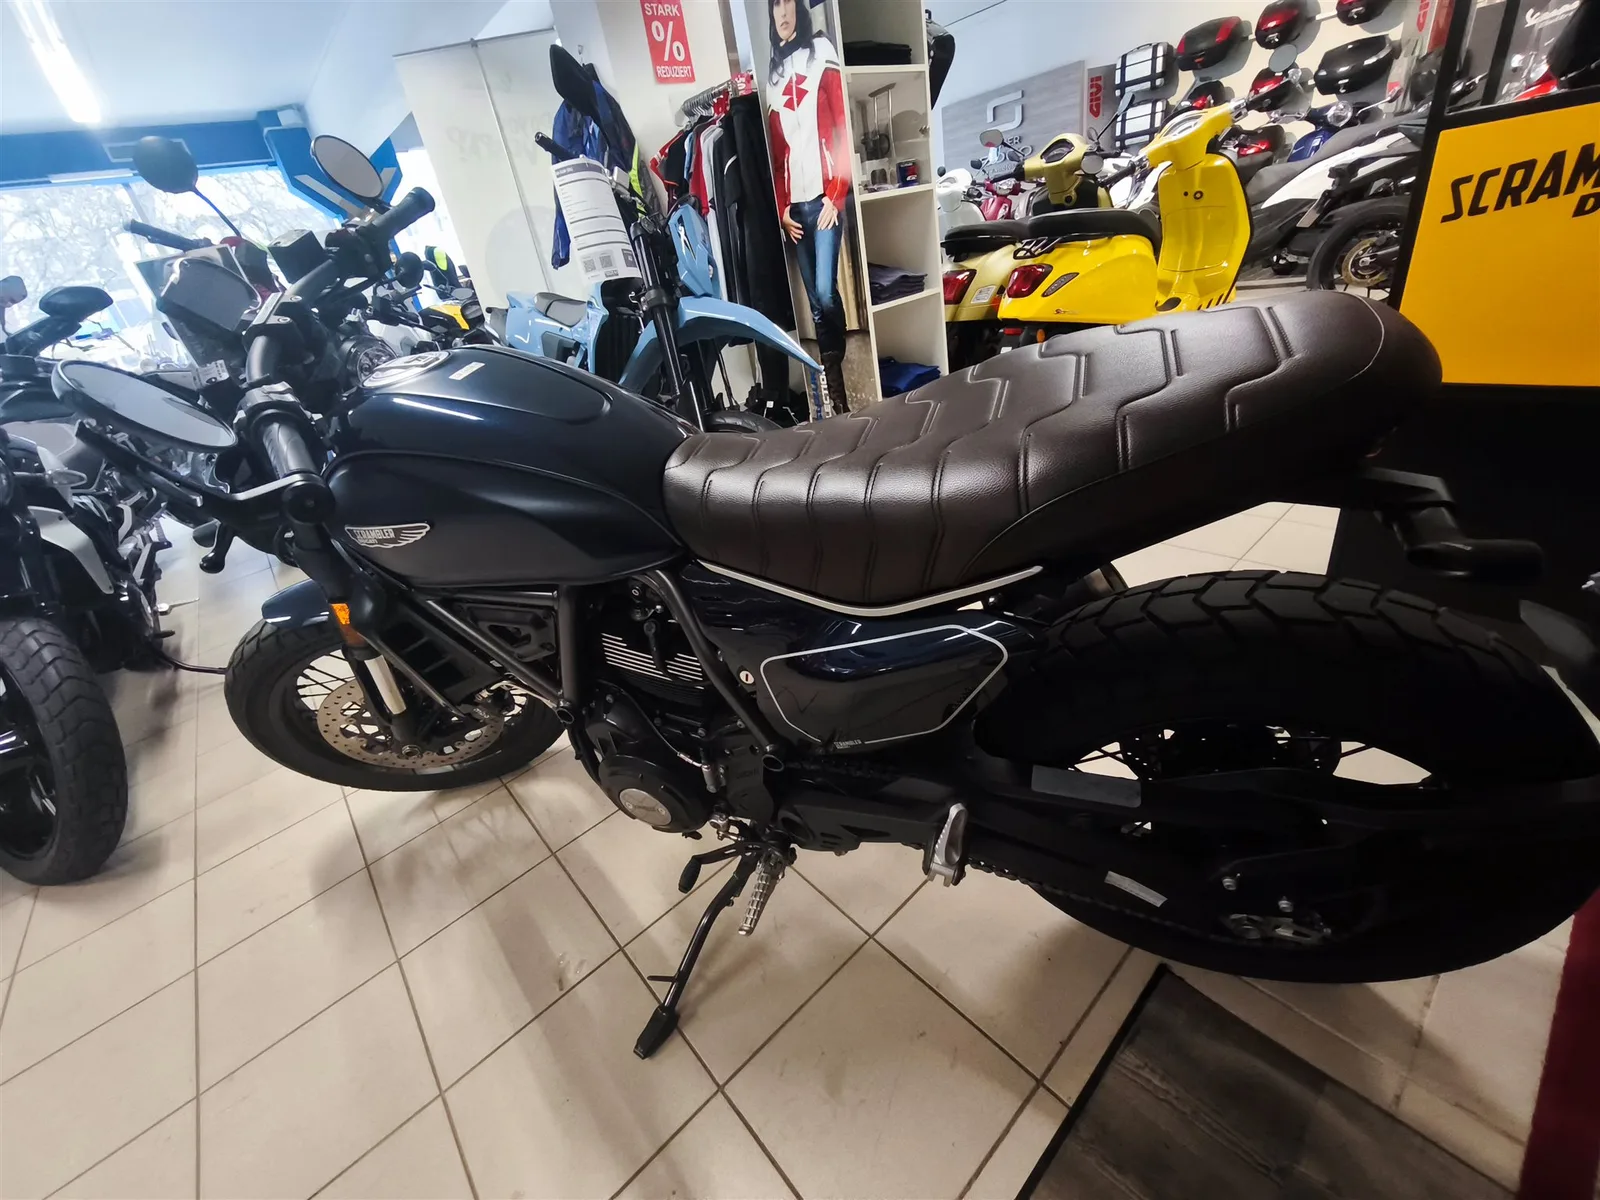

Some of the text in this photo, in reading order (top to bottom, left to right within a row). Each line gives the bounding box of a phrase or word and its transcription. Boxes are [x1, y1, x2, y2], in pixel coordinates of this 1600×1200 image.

[644, 3, 680, 16] STARK
[656, 65, 692, 78] REDUZIERT
[353, 528, 396, 539] SCRAMBLER
